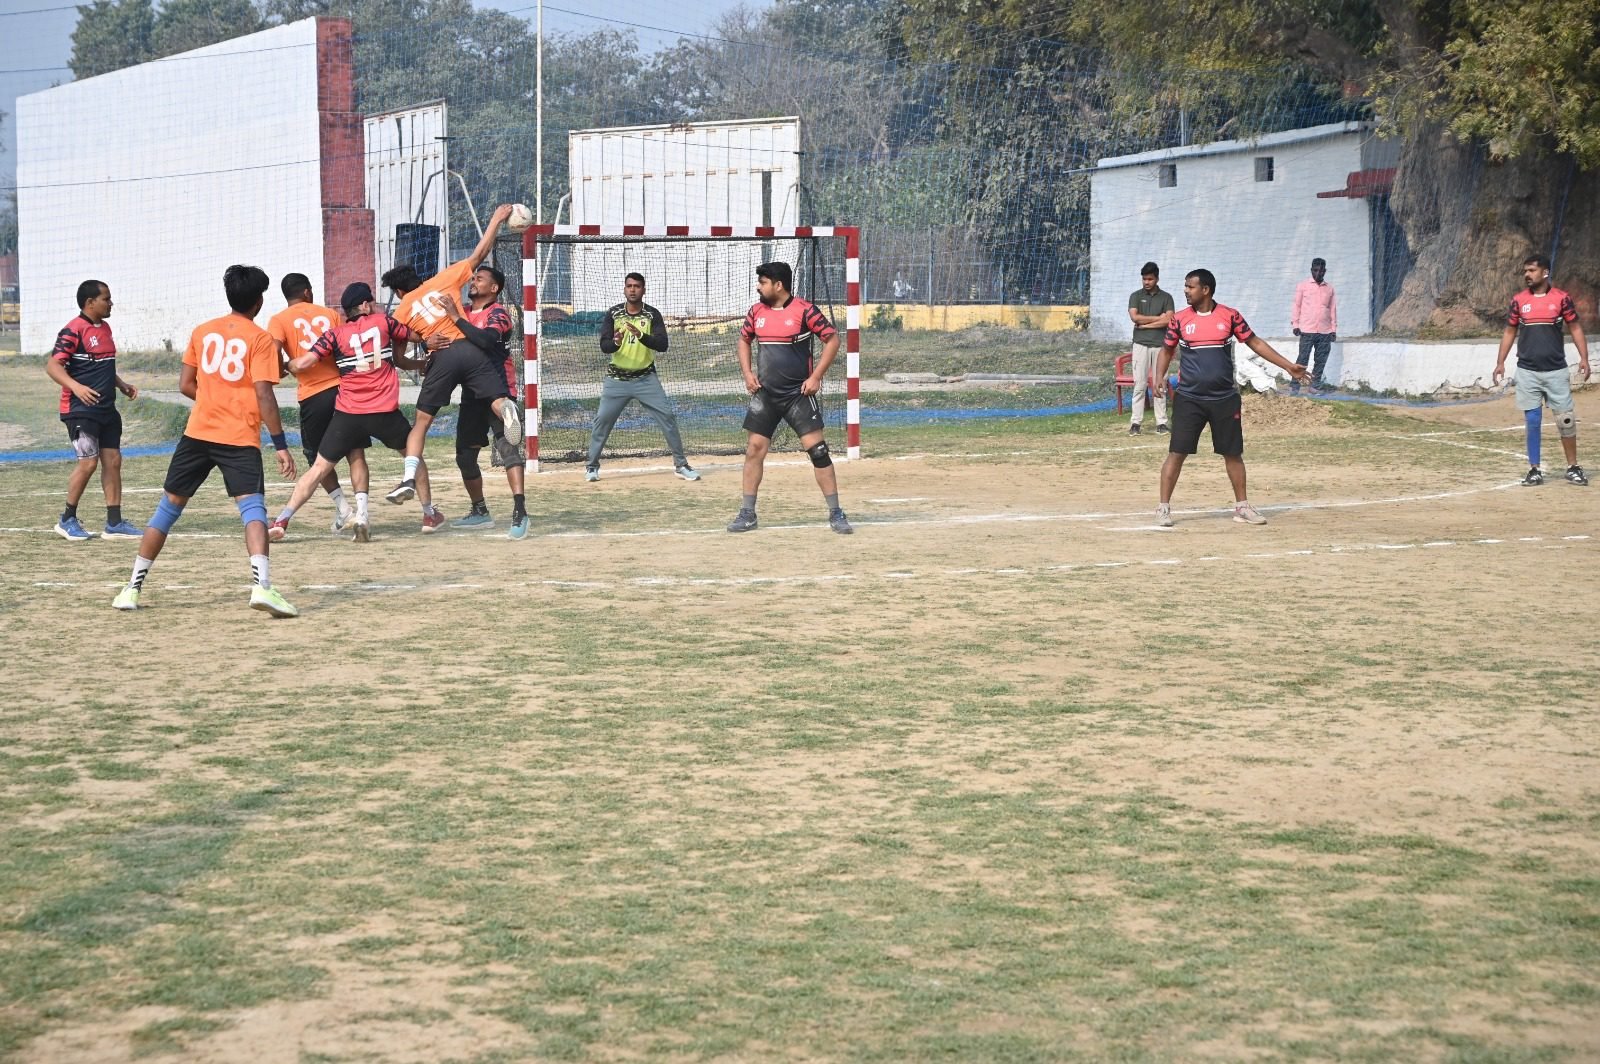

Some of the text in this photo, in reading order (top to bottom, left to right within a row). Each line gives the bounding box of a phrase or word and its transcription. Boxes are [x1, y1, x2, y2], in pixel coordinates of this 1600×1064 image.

[201, 332, 247, 382] 08
[349, 326, 382, 372] 17
[628, 334, 636, 345] 12
